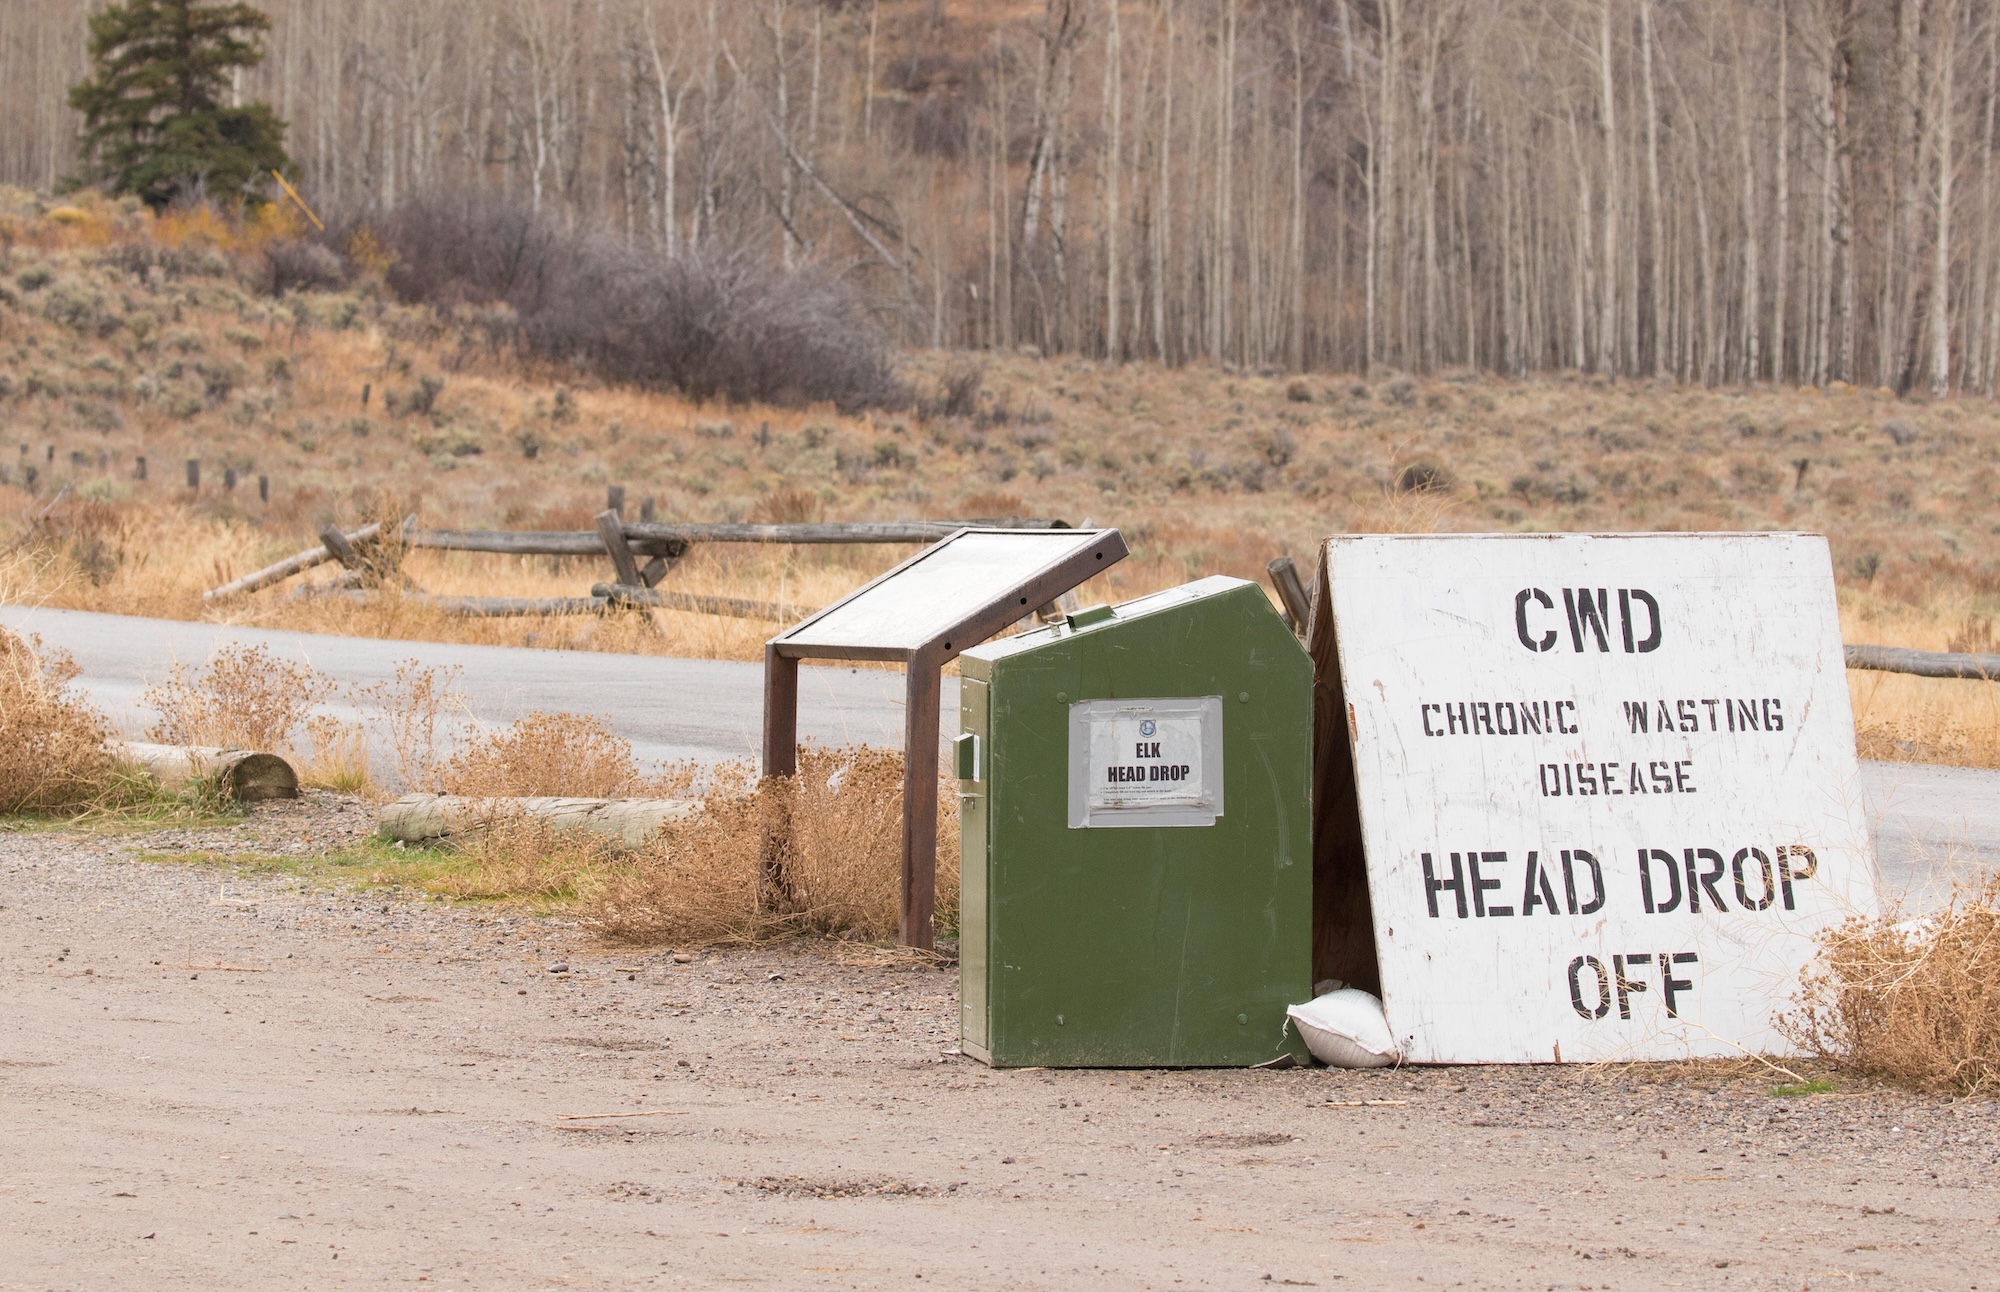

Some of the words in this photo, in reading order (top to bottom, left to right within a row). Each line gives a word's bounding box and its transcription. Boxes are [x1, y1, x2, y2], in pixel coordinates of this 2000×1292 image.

[1516, 588, 1661, 653] CWD
[1422, 701, 1577, 736] CHRONIC
[1624, 699, 1783, 733] WASTING
[1136, 743, 1161, 758] ELK
[1108, 767, 1145, 782] HEAD
[1150, 765, 1189, 781] DROP
[1540, 762, 1697, 796] DISEASE
[1422, 850, 1605, 918] HEAD
[1638, 845, 1818, 913] DROP
[1568, 953, 1698, 1019] OFF
